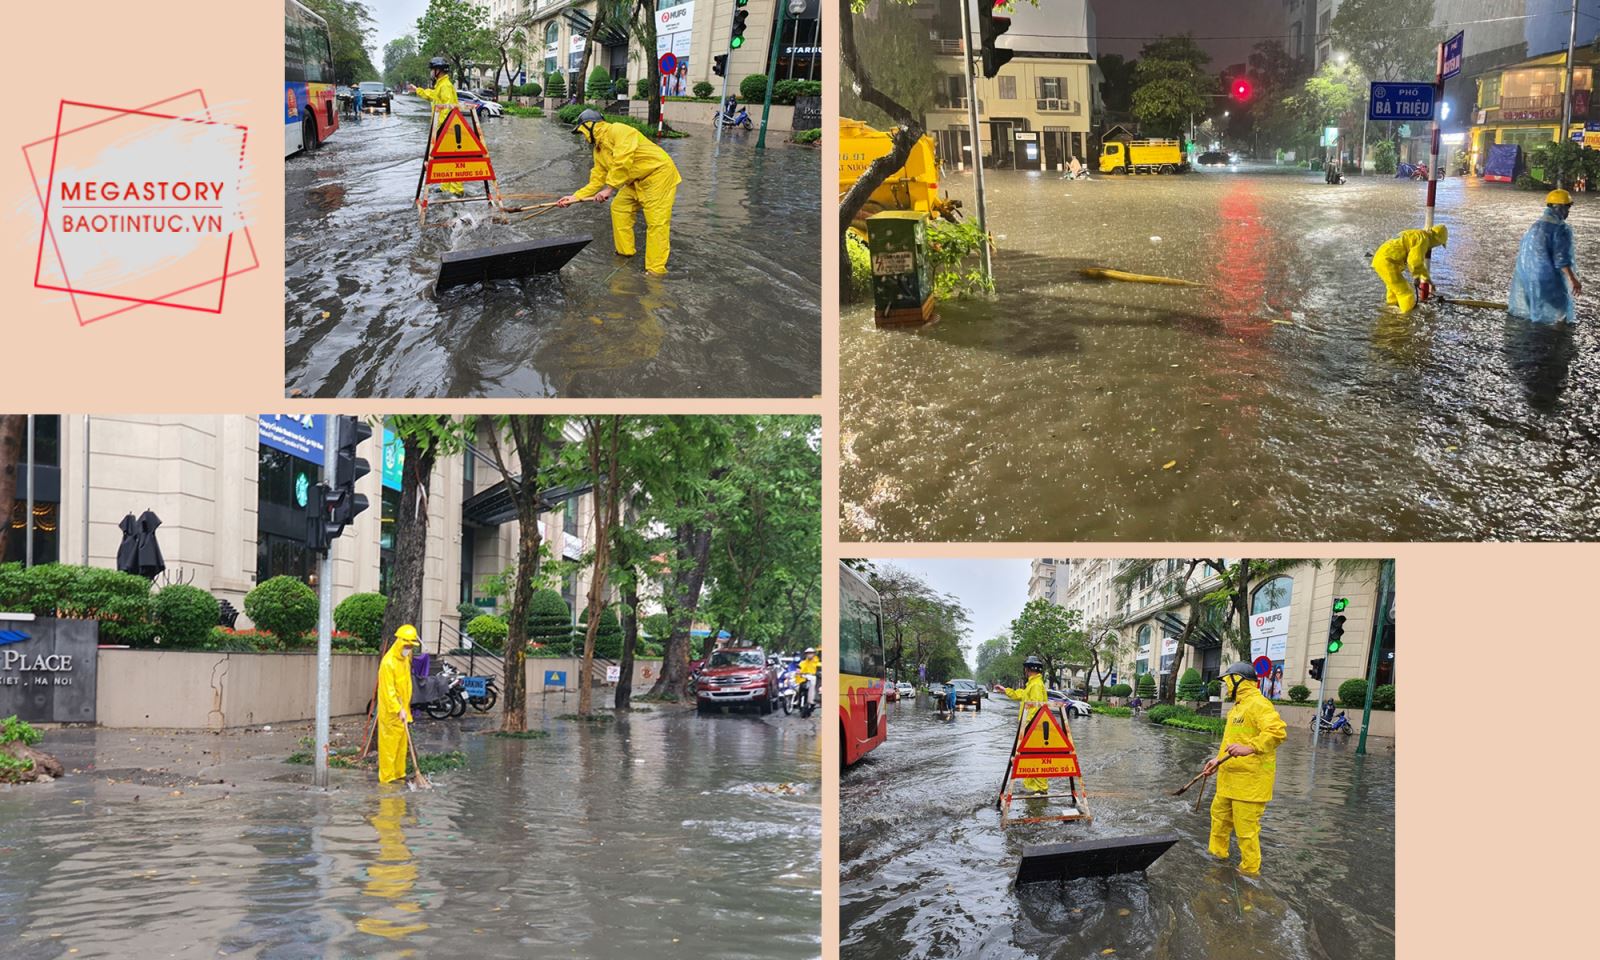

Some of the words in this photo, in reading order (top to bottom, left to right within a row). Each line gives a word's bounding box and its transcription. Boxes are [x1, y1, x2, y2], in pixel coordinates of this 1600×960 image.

[1398, 87, 1419, 96] PHỐ
[1375, 98, 1391, 114] BÀ
[1396, 98, 1430, 117] TRIỆU
[2, 649, 73, 671] PLACE
[54, 677, 73, 685] NOI
